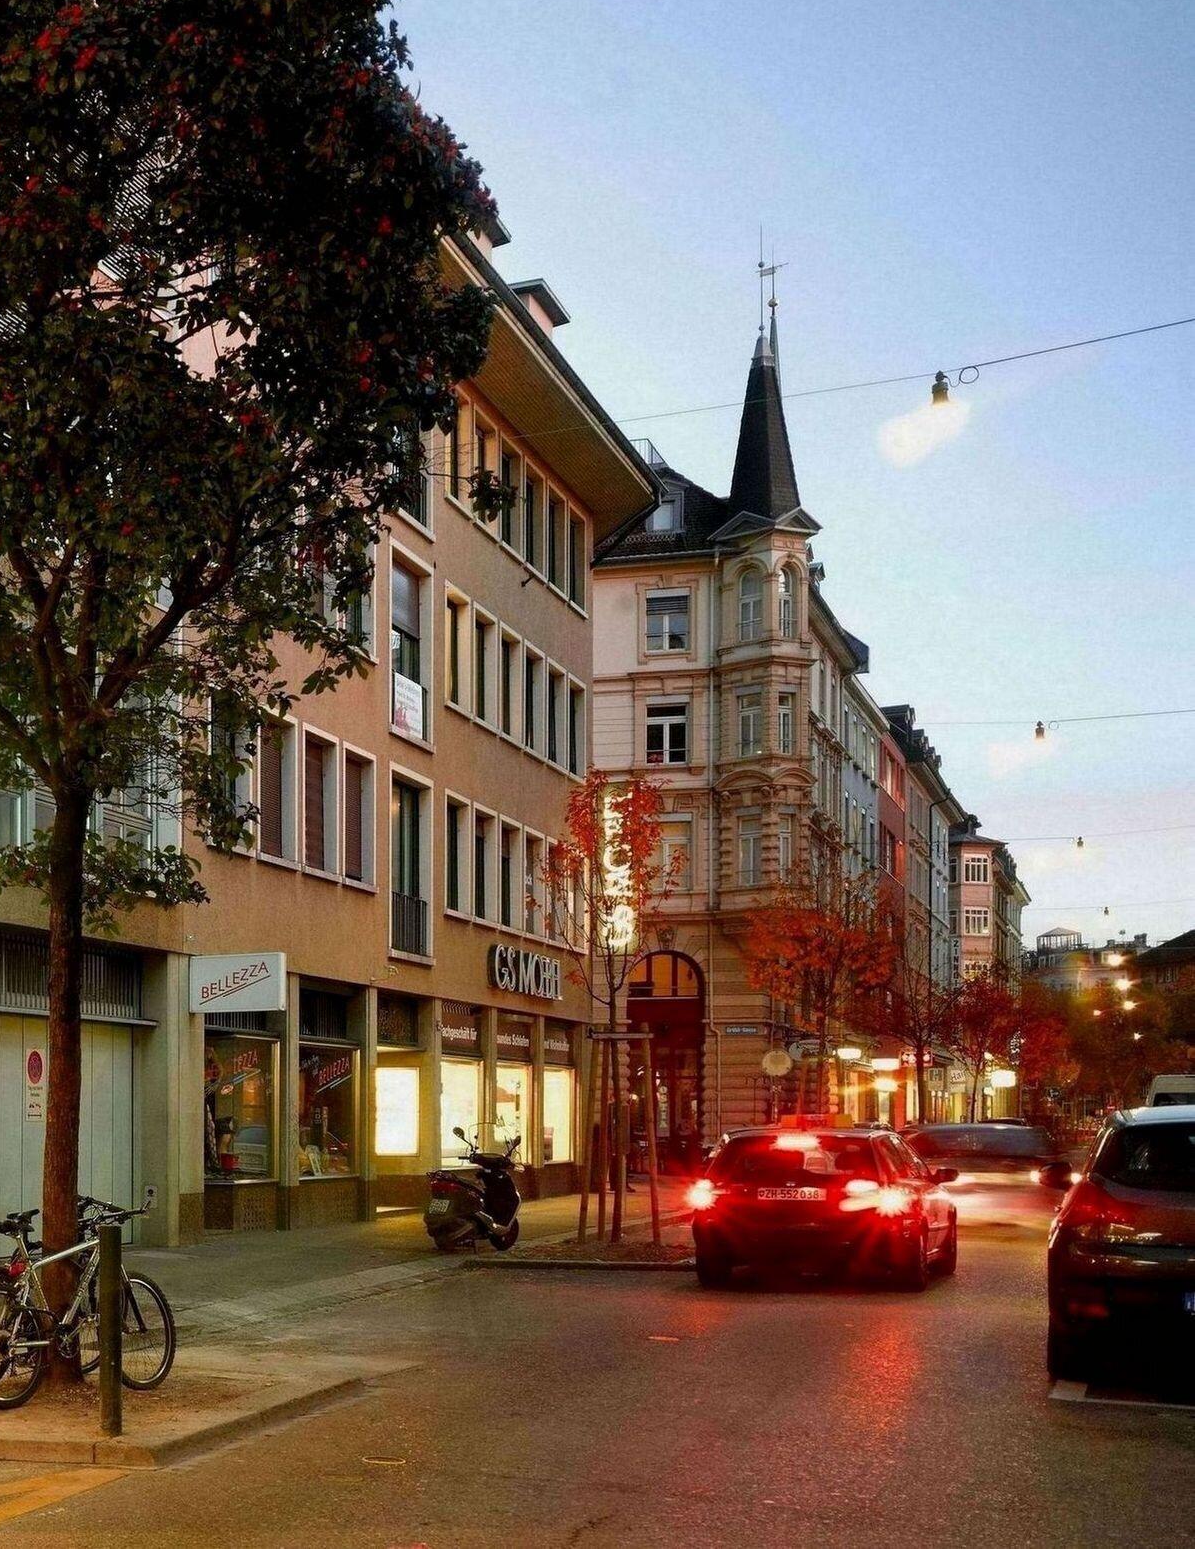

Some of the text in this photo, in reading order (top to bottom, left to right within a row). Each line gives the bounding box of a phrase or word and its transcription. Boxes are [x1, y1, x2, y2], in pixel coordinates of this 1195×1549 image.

[201, 961, 269, 999] BELLEZZA
[494, 943, 517, 992] GS
[318, 1056, 350, 1086] BELLEZZA
